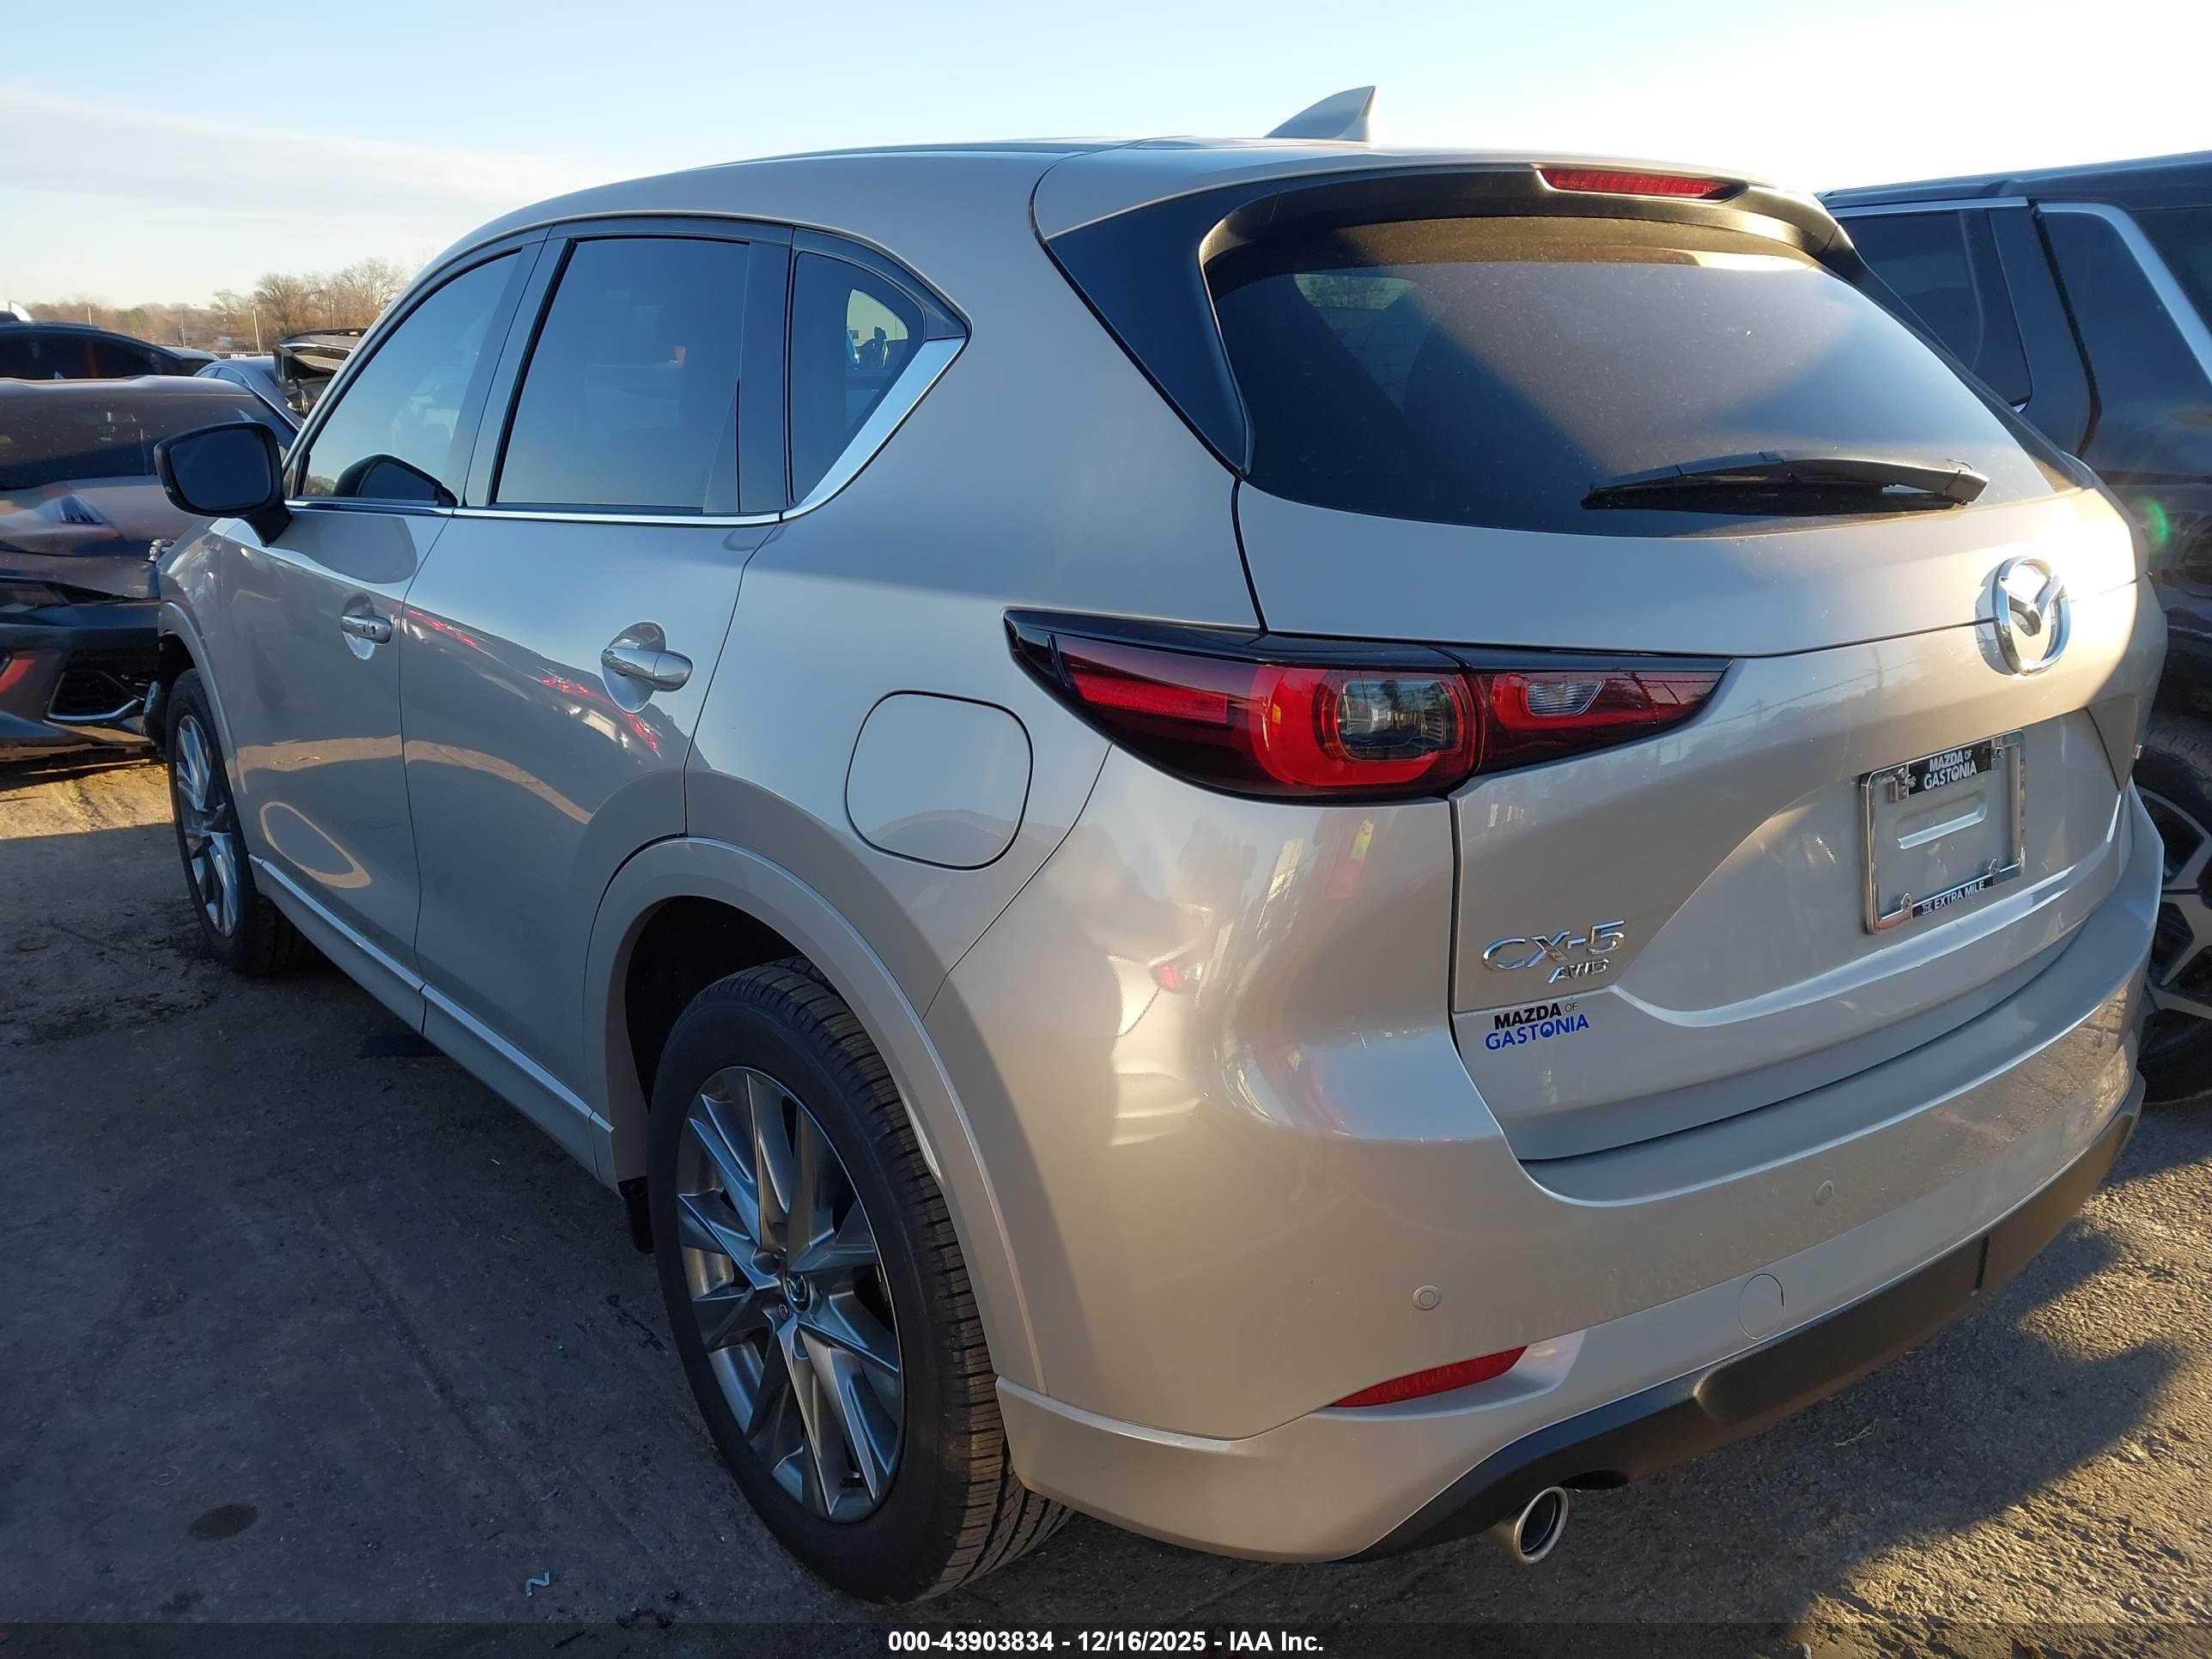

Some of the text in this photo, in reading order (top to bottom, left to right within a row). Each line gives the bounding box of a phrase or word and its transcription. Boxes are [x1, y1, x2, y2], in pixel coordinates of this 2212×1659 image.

[1923, 760, 1978, 790] GASTONIA
[1929, 749, 1973, 772] MAZDA OF
[1934, 890, 1964, 910] EXTRA
[1965, 880, 1985, 898] MILE
[1482, 920, 1625, 970] CX-5
[1547, 957, 1610, 984] AWD
[1494, 1001, 1579, 1030] MAZDA OF
[1485, 1013, 1590, 1050] GASTONIA
